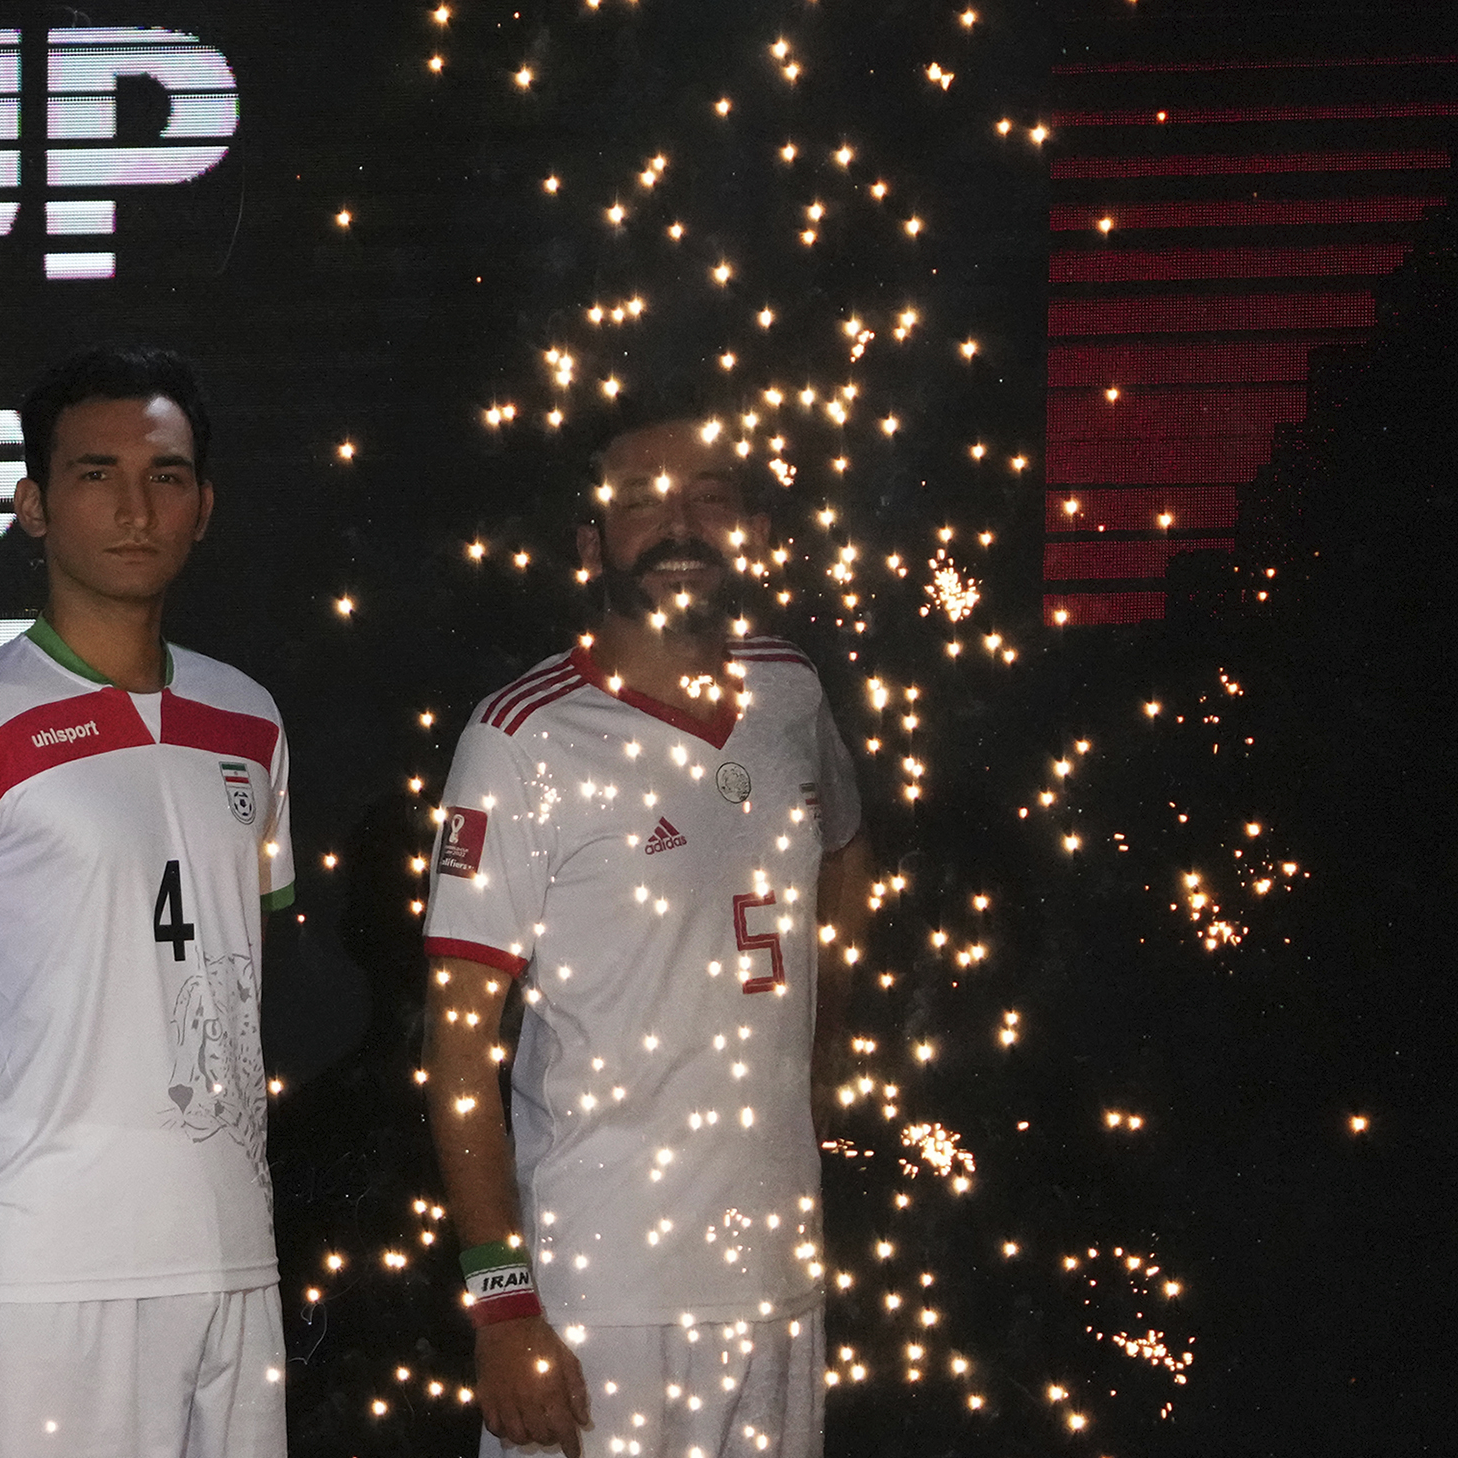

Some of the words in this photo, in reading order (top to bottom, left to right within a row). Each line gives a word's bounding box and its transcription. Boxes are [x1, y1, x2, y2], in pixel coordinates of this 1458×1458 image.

[31, 720, 99, 747] uhlsport
[644, 834, 687, 855] adidas
[153, 859, 195, 962] 4
[732, 890, 786, 995] 5
[482, 1271, 529, 1292] IRAN
